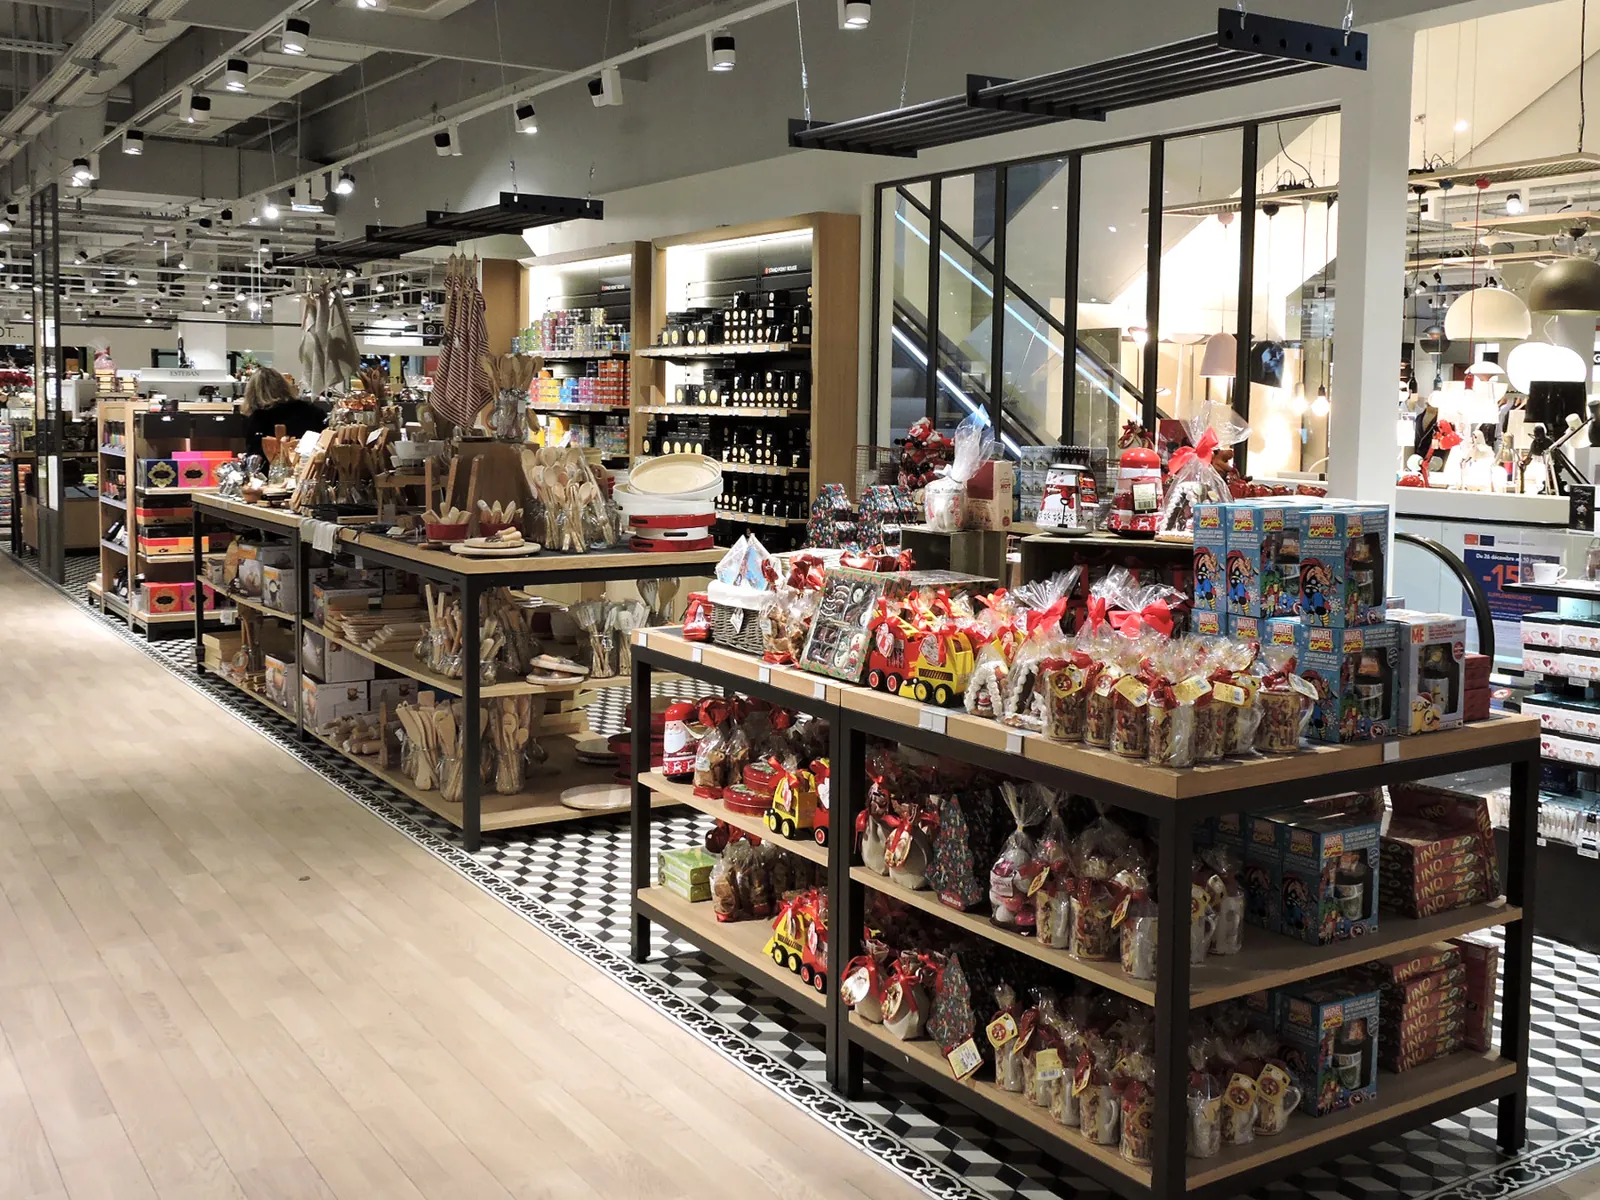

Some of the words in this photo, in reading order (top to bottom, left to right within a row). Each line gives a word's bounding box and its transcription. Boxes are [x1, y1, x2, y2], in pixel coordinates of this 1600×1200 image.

[1309, 526, 1337, 538] COMICS
[1412, 628, 1424, 643] ME
[1309, 640, 1333, 652] COMICS
